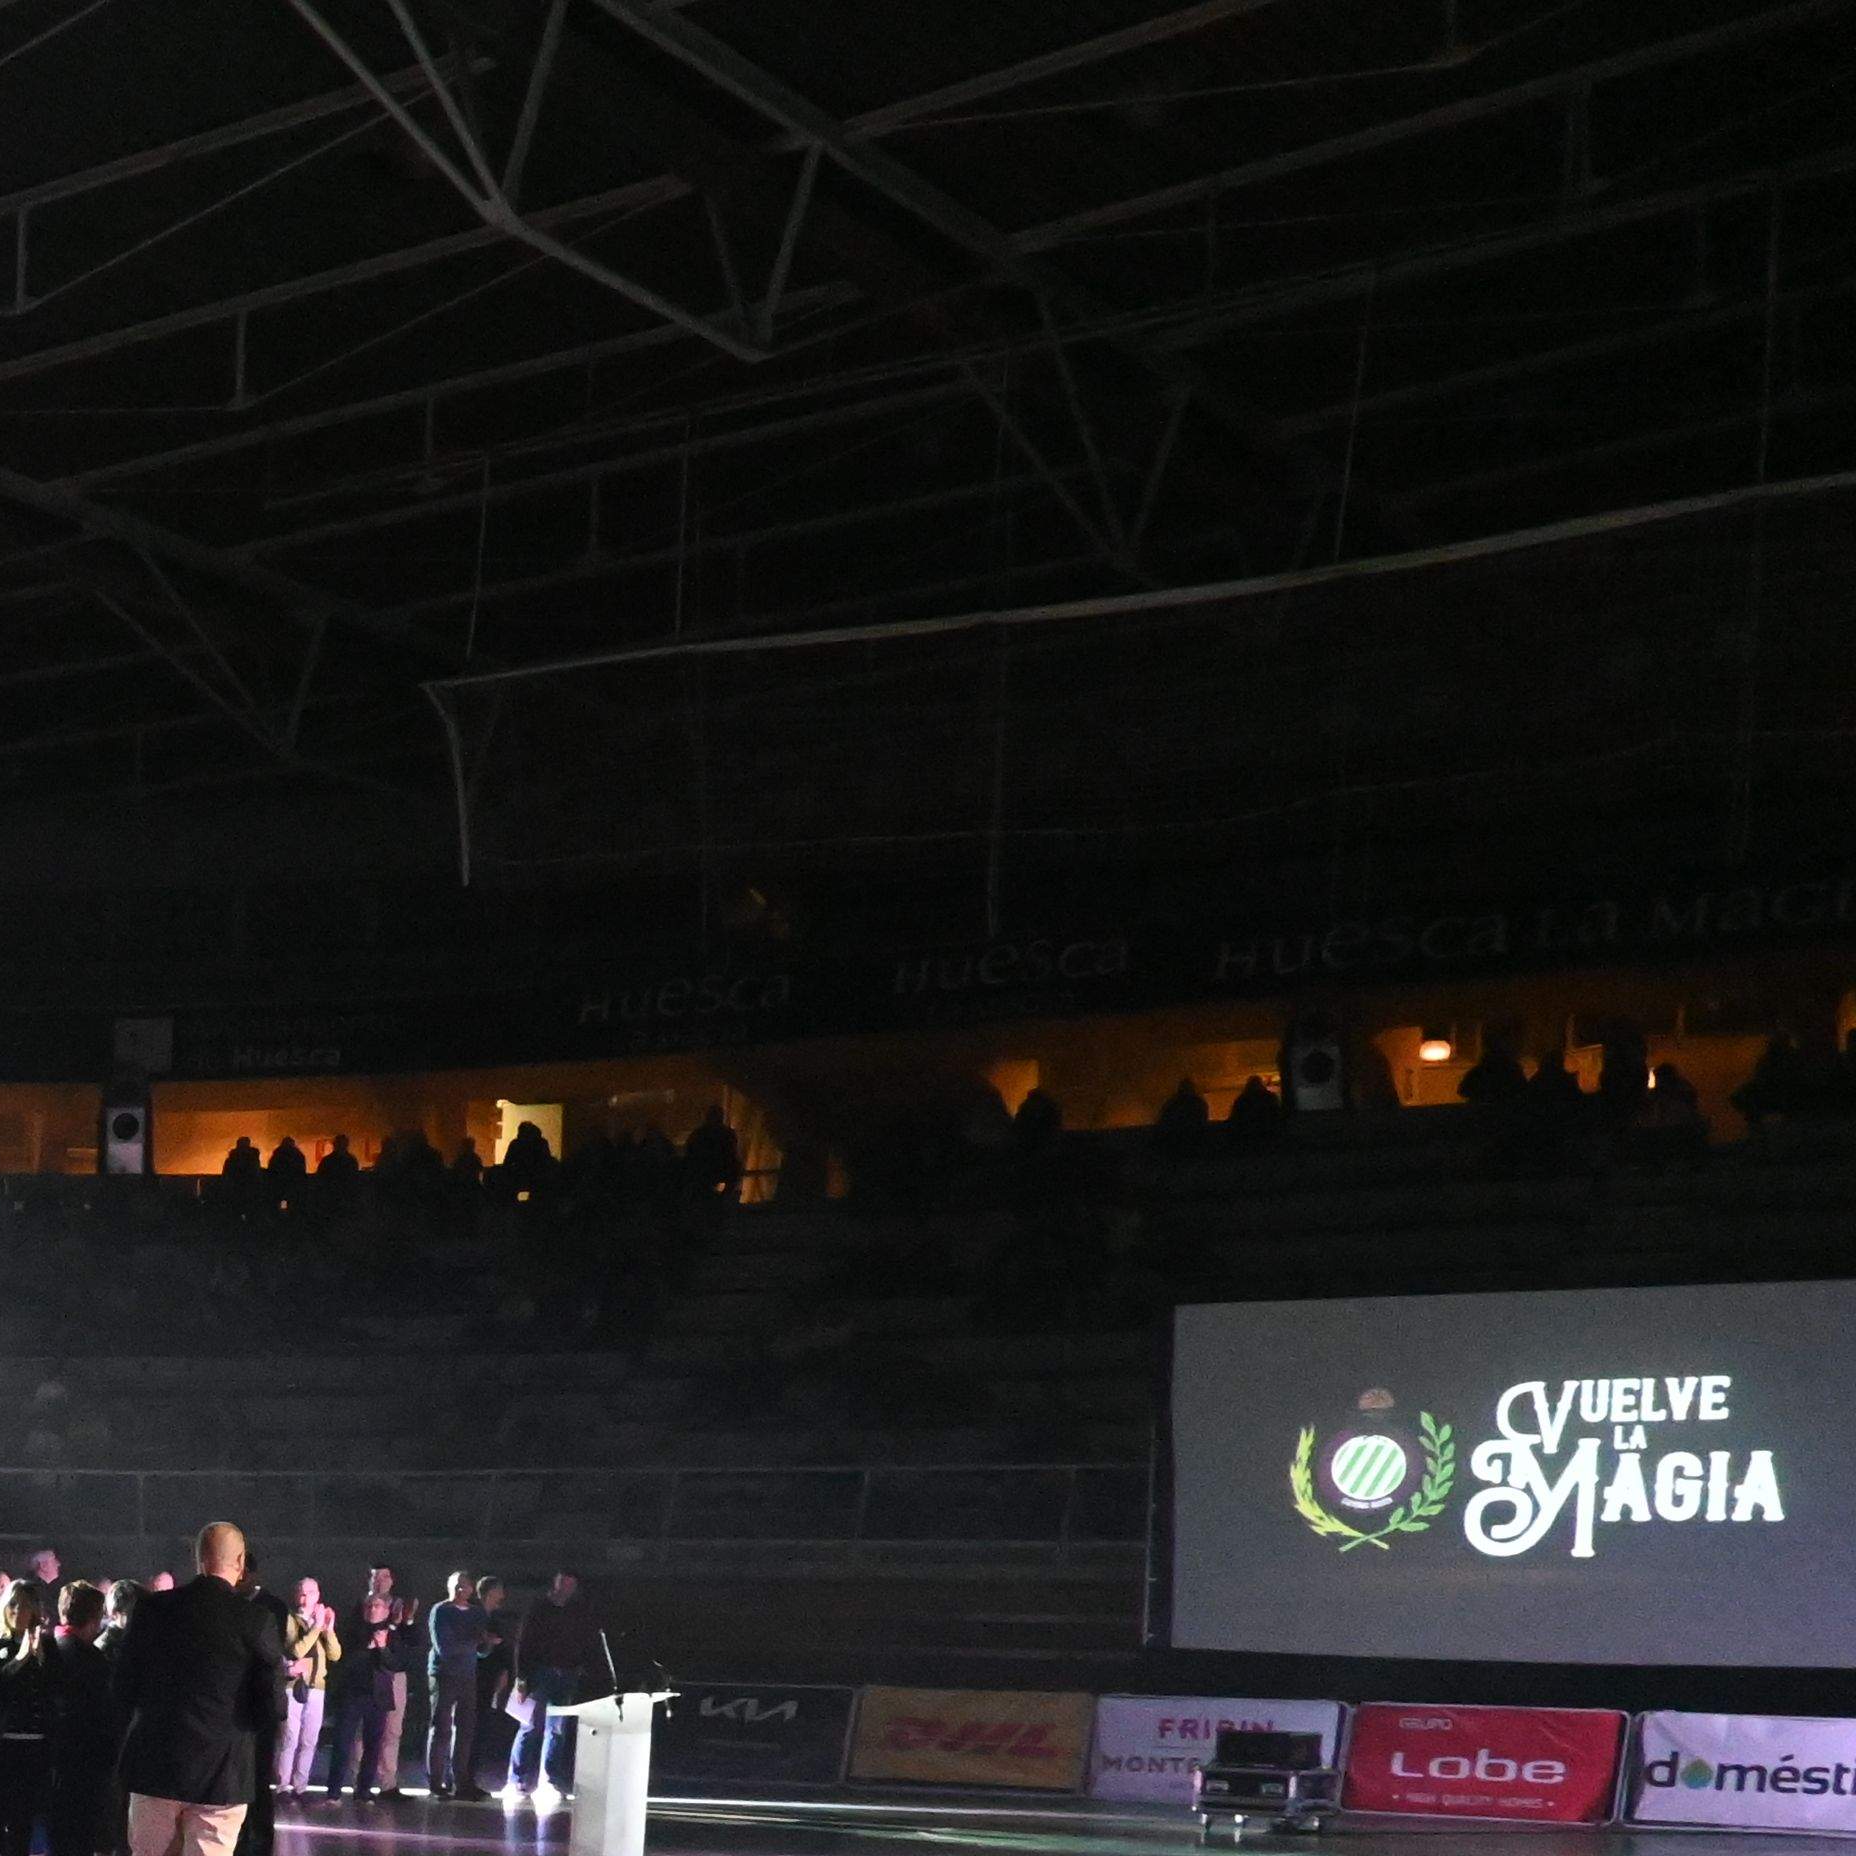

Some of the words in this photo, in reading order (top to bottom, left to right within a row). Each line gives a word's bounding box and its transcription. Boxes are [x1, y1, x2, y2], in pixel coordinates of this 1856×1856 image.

[1496, 1375, 1731, 1454] VUELVE
[1613, 1424, 1648, 1450] LA
[1464, 1438, 1785, 1557] MAGIA
[1390, 1749, 1566, 1784] Lobe
